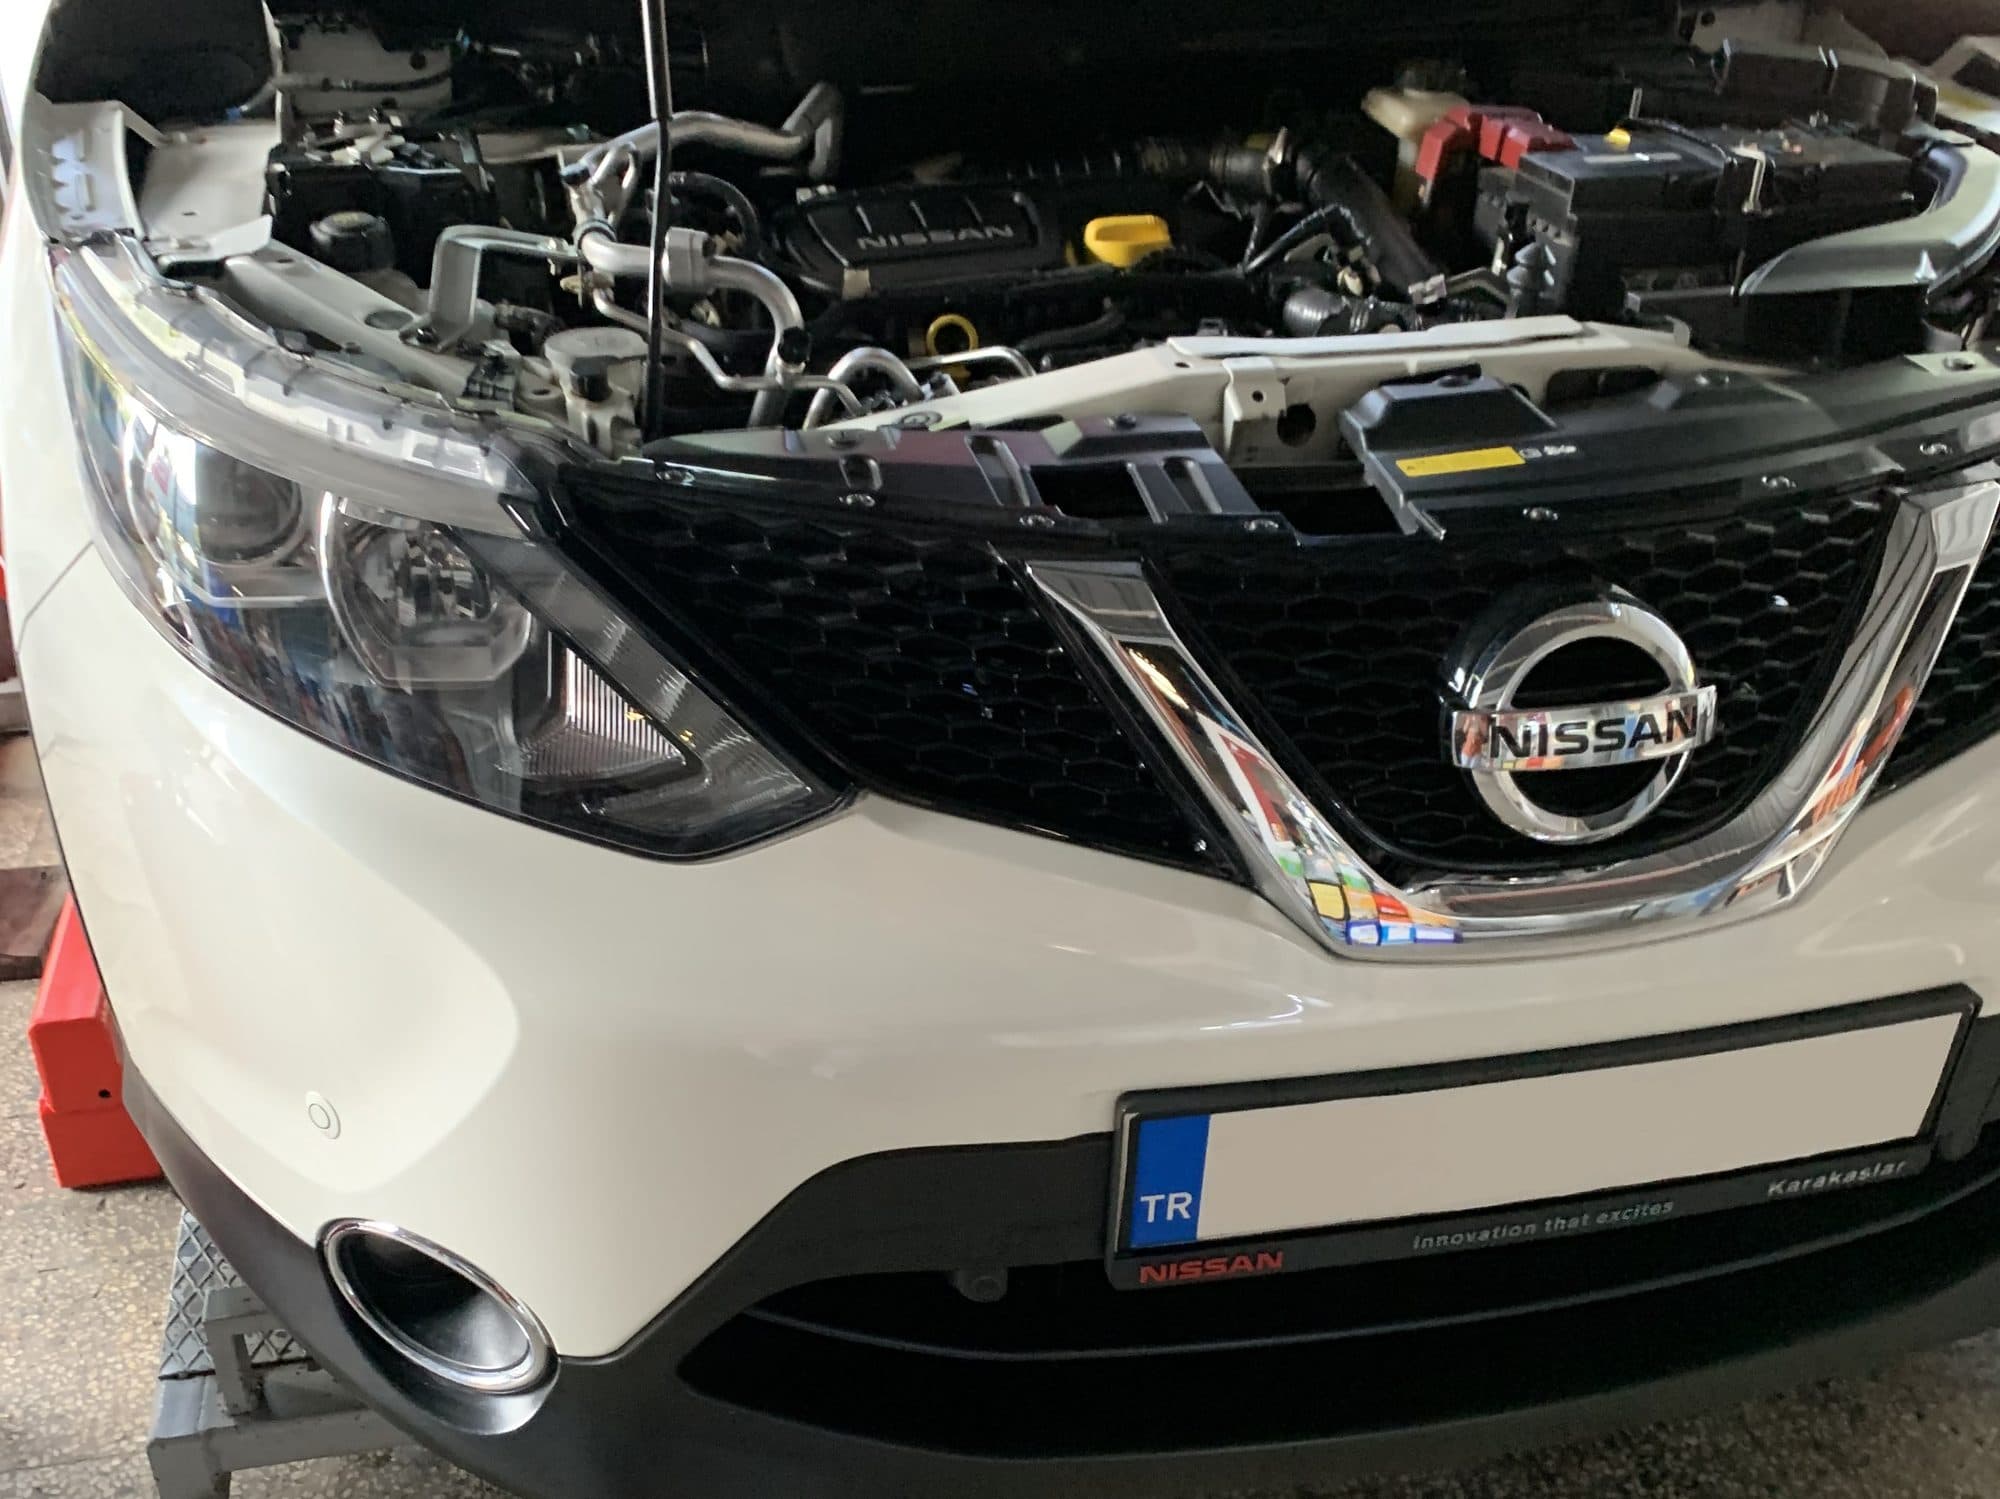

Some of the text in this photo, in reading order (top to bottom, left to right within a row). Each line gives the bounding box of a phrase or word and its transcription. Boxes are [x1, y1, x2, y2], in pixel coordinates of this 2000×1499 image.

[857, 225, 1013, 249] NISSAN
[1490, 704, 1698, 758] NISSAN
[1140, 1192, 1192, 1223] TR
[1544, 1213, 1589, 1232] that
[1596, 1201, 1673, 1224] excites
[1140, 1251, 1283, 1284] NISSAN
